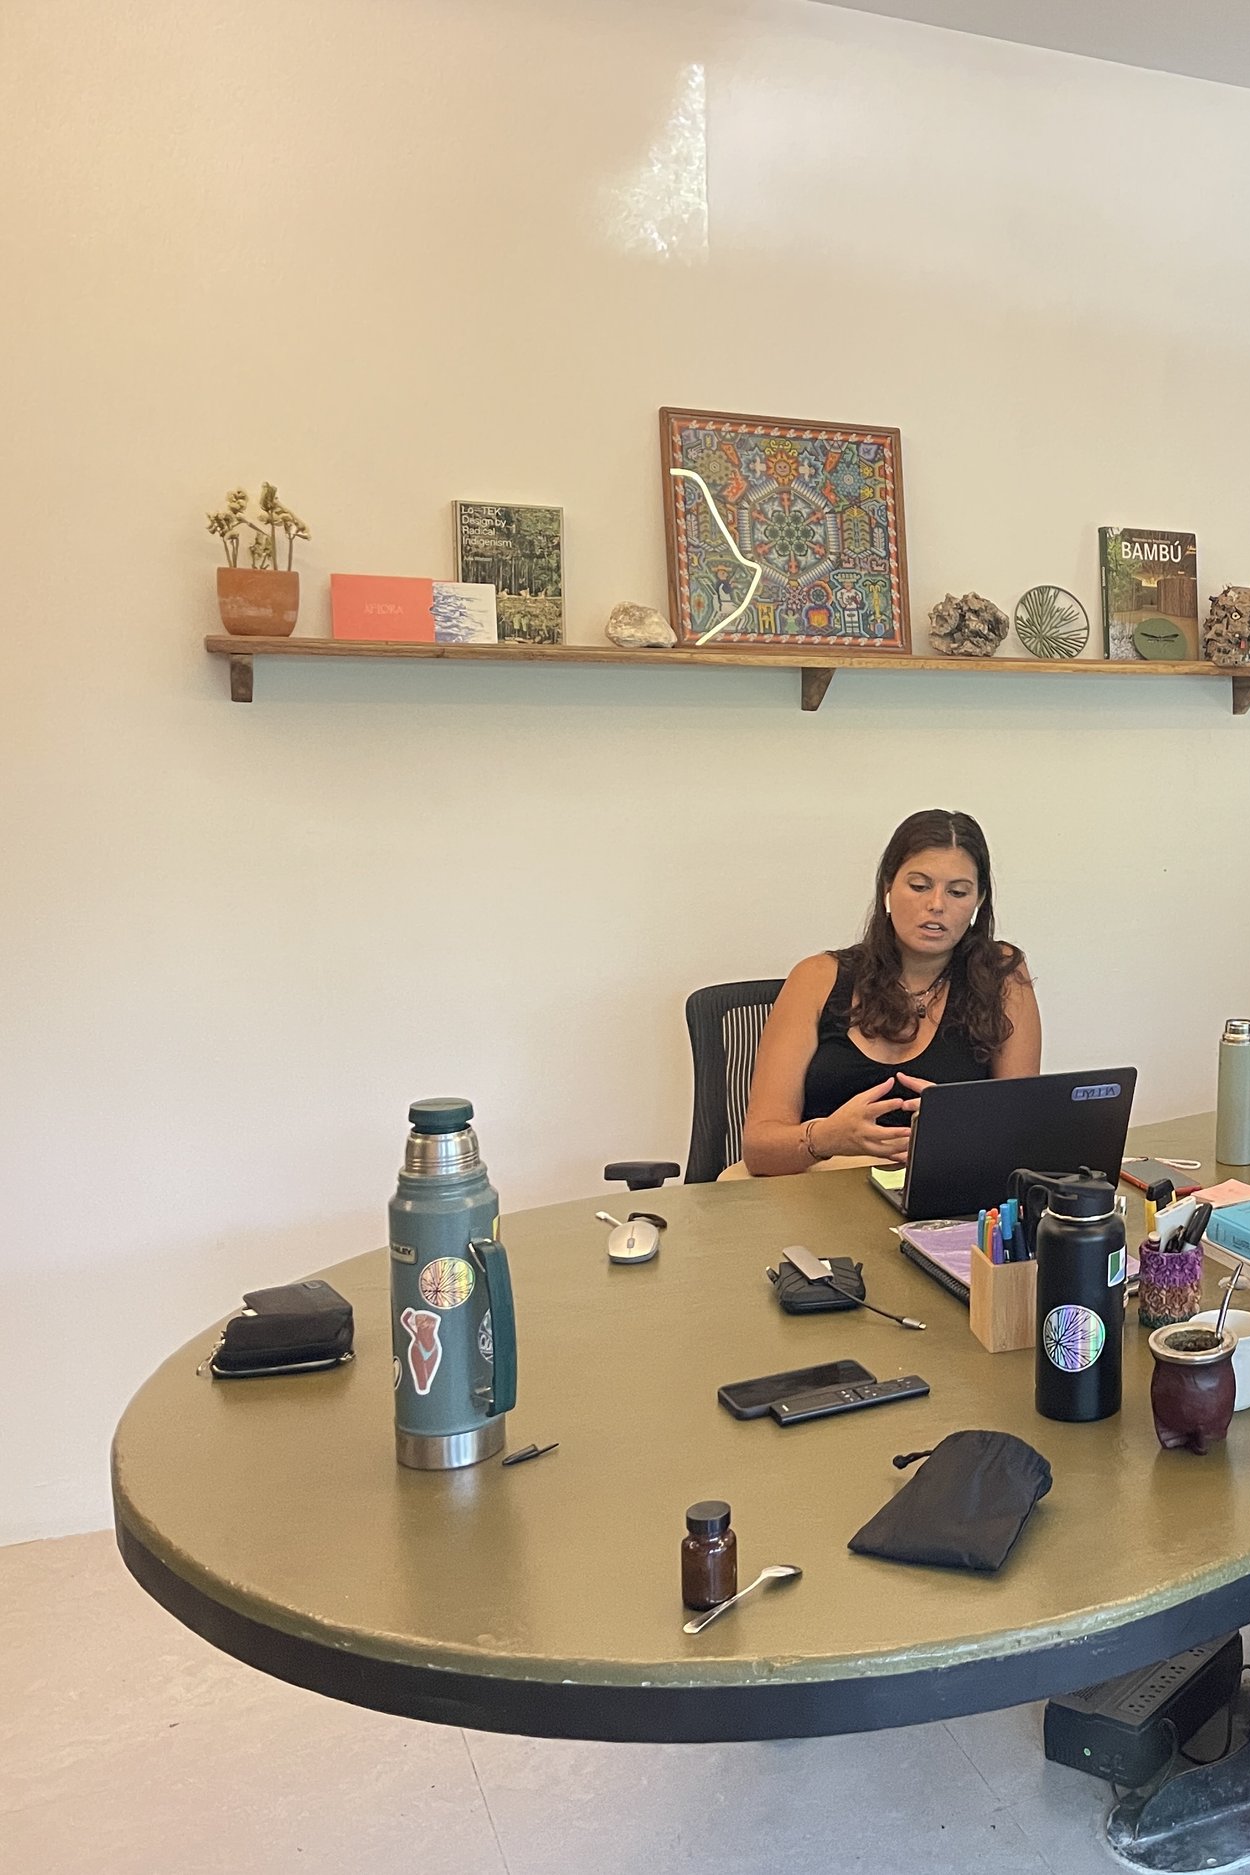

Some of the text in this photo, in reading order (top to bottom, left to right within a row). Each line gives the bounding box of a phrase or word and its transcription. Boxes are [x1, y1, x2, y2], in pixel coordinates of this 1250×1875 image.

[462, 515, 507, 528] Design by
[462, 525, 496, 536] Radical
[462, 535, 512, 548] Indigenism
[1121, 540, 1182, 563] BAMBÚ
